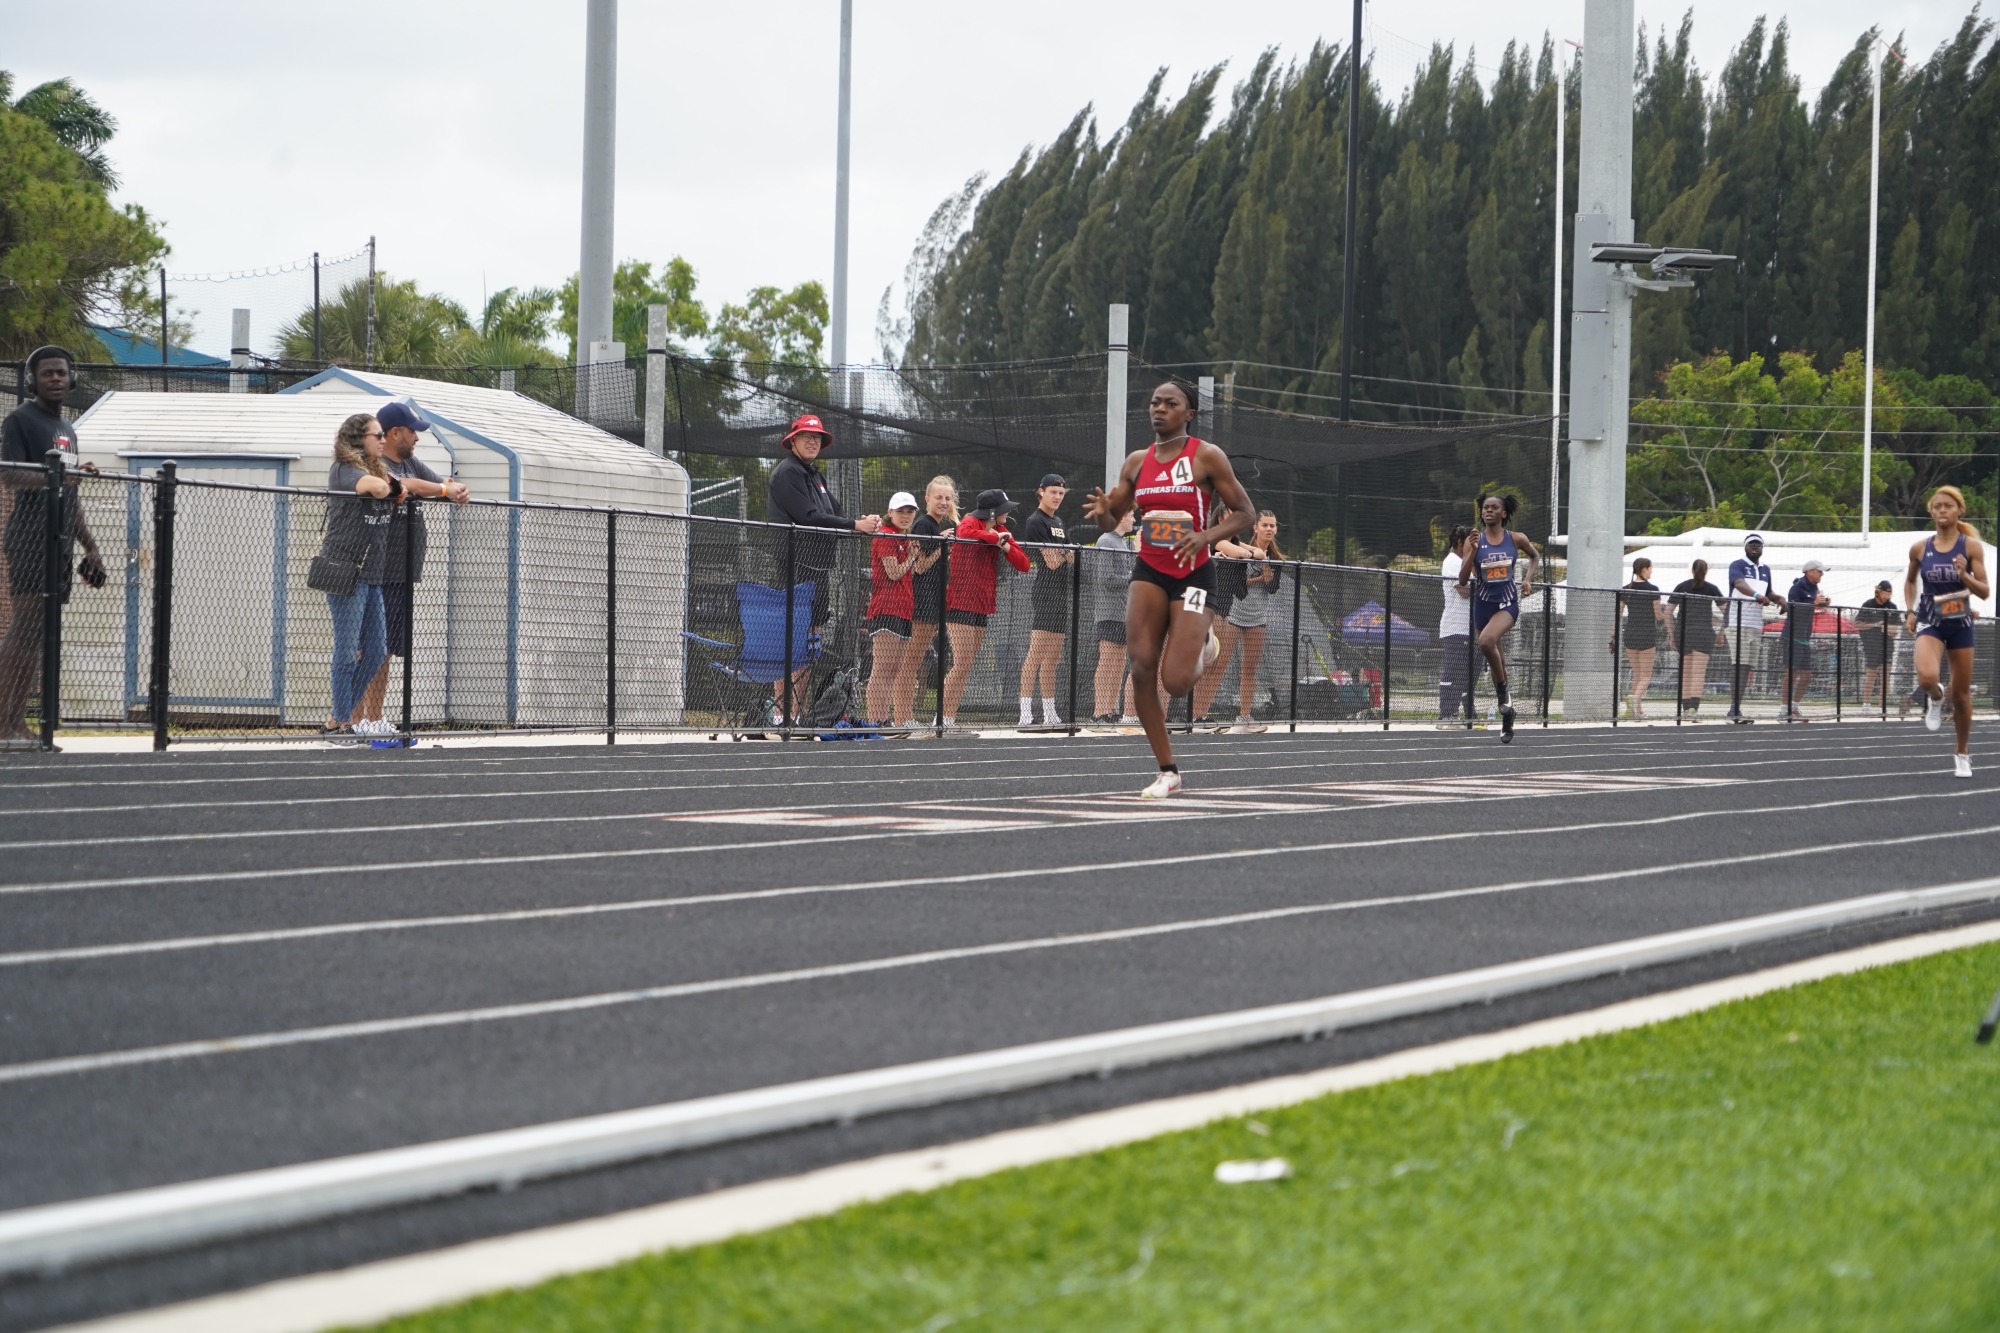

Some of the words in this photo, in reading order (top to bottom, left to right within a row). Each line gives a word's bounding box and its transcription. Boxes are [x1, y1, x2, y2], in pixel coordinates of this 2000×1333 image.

[1176, 459, 1189, 482] 4
[1150, 521, 1182, 541] 221
[1487, 567, 1508, 579] 283
[1188, 590, 1201, 611] 4
